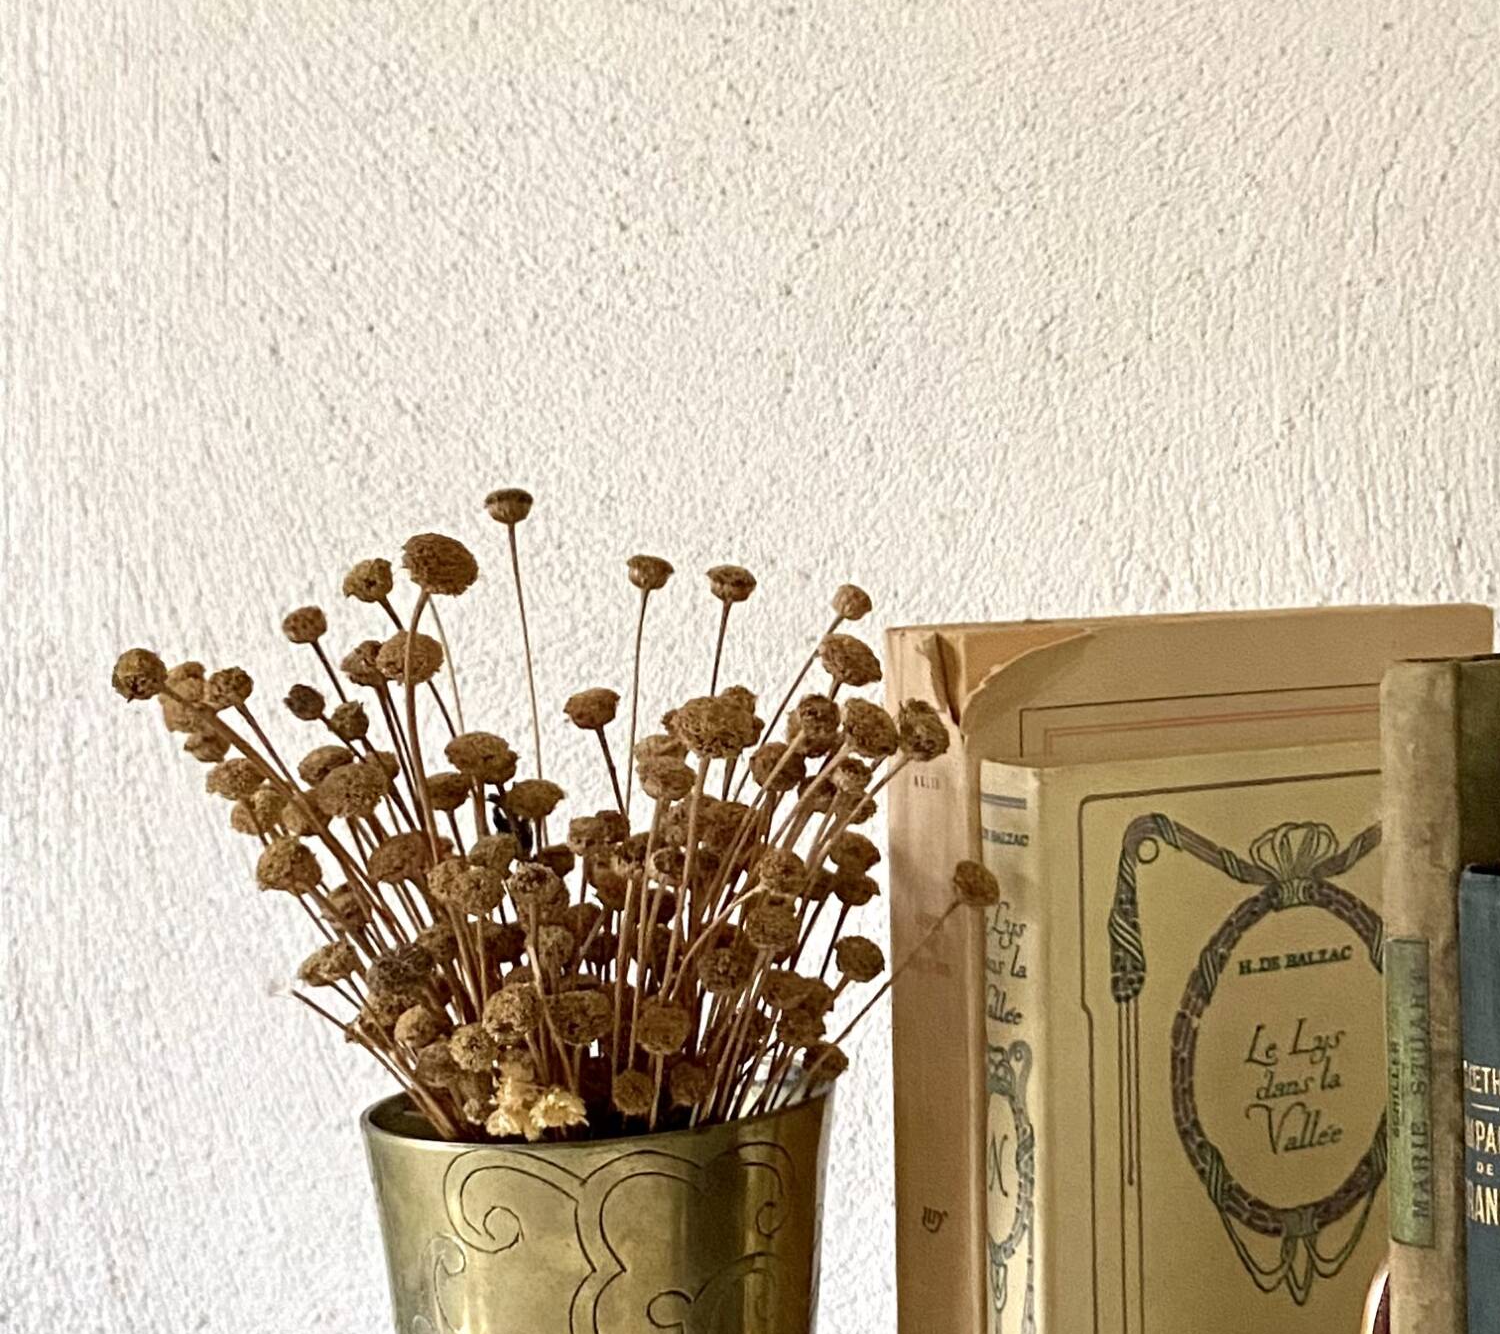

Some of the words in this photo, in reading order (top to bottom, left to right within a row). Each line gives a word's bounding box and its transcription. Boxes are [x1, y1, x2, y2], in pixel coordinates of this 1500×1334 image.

[1010, 945, 1028, 979] la
[1259, 956, 1280, 972] DE
[1284, 945, 1352, 969] BALZAC
[1245, 1024, 1279, 1066] Le
[1289, 1018, 1345, 1065] Lys
[1256, 1069, 1315, 1101] dans
[1320, 1056, 1341, 1091] la
[1245, 1101, 1344, 1155] Vallée
[1476, 1161, 1495, 1176] DE
